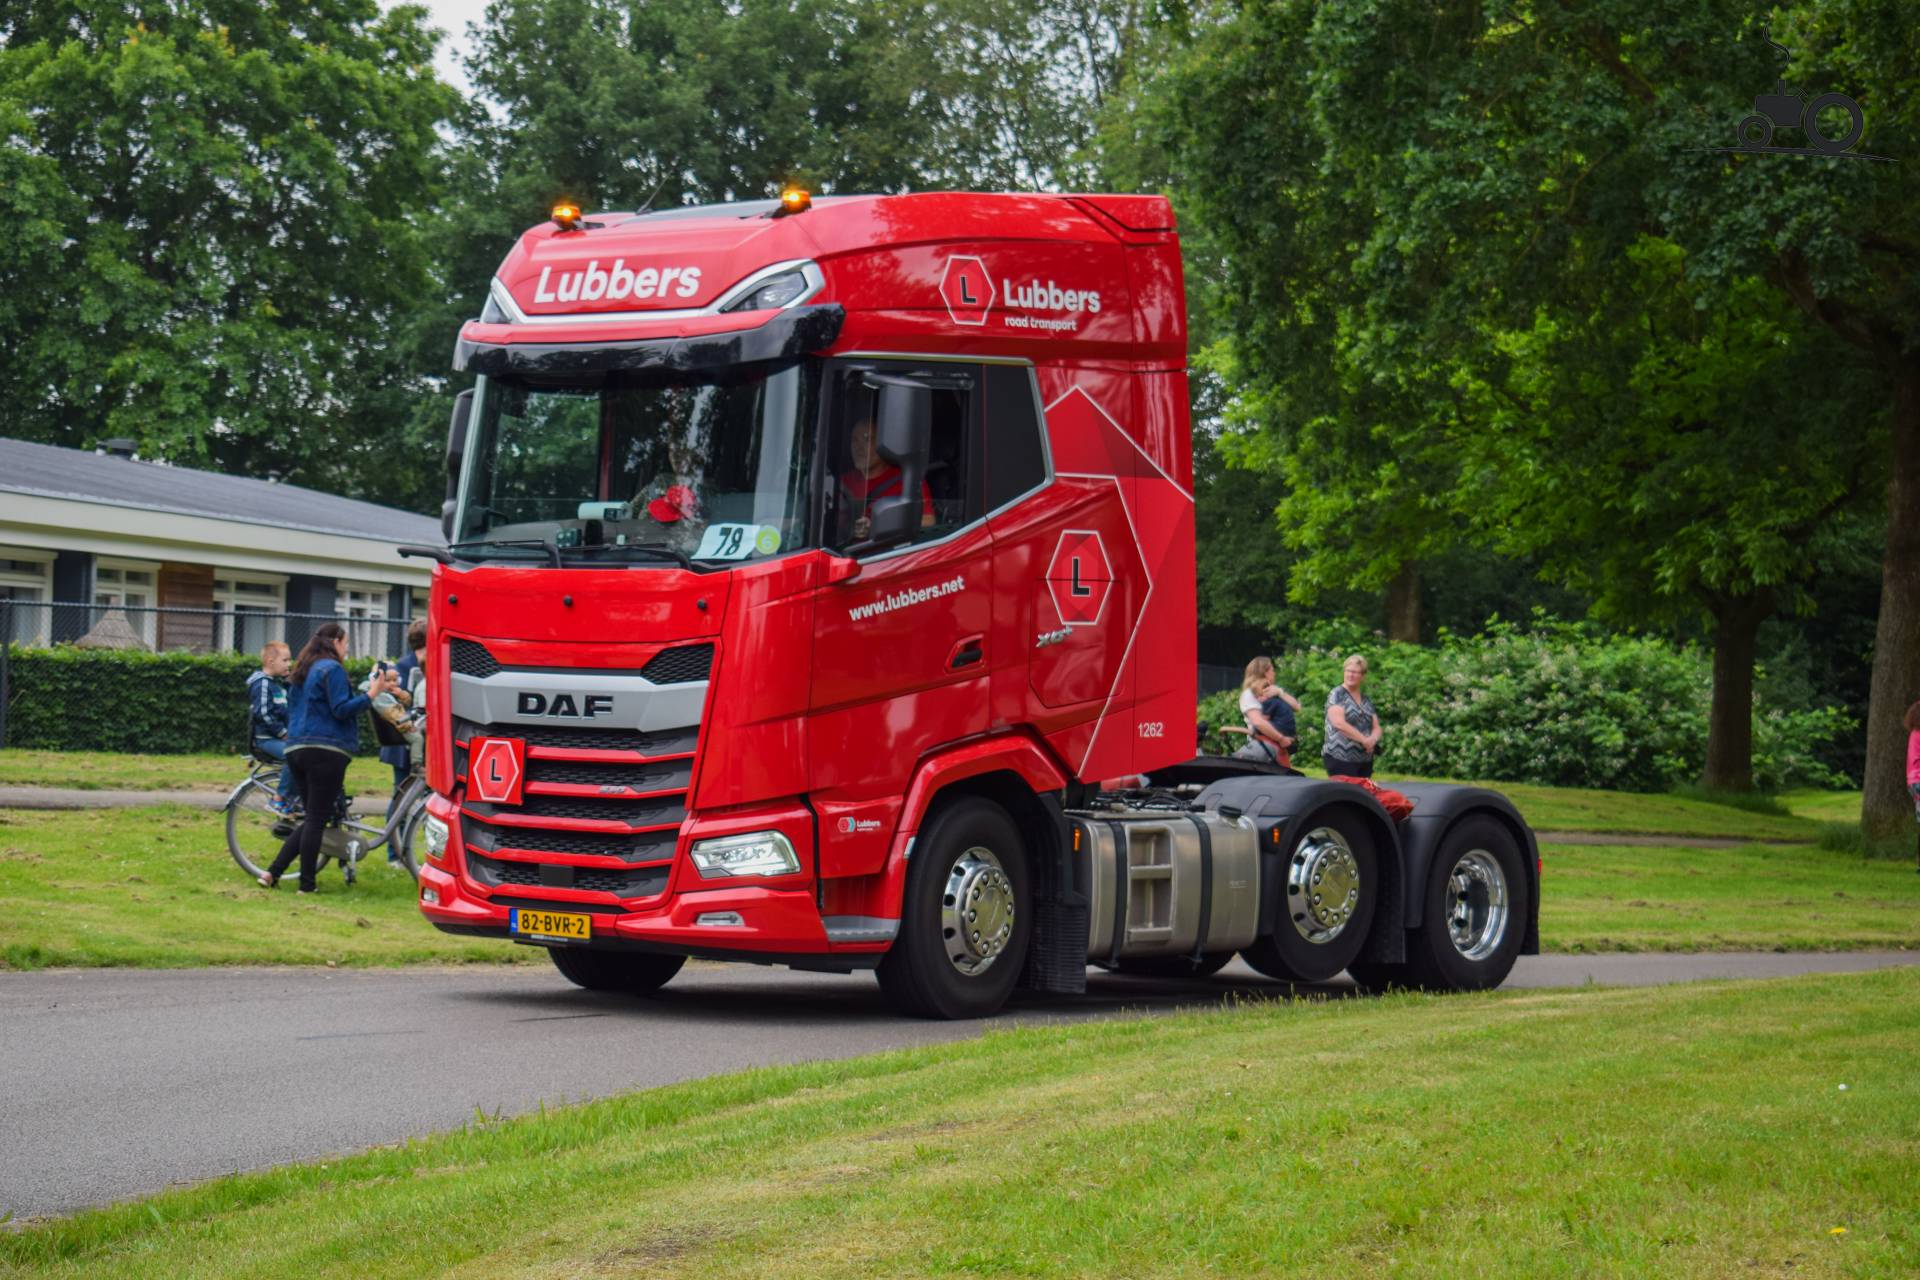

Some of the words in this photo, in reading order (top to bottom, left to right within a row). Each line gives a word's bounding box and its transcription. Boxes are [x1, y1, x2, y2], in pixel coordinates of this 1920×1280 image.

[534, 259, 702, 303] Lubbers
[960, 275, 977, 304] L
[1003, 278, 1102, 313] Lubbers
[1005, 316, 1028, 328] road
[1031, 316, 1076, 332] transport
[712, 526, 744, 557] 78
[1071, 556, 1091, 597] L
[848, 575, 965, 621] www.lubbers.net
[517, 691, 614, 719] DAF
[1138, 721, 1164, 737] 1262
[489, 758, 503, 782] L
[521, 913, 585, 935] 82-BVR-2
